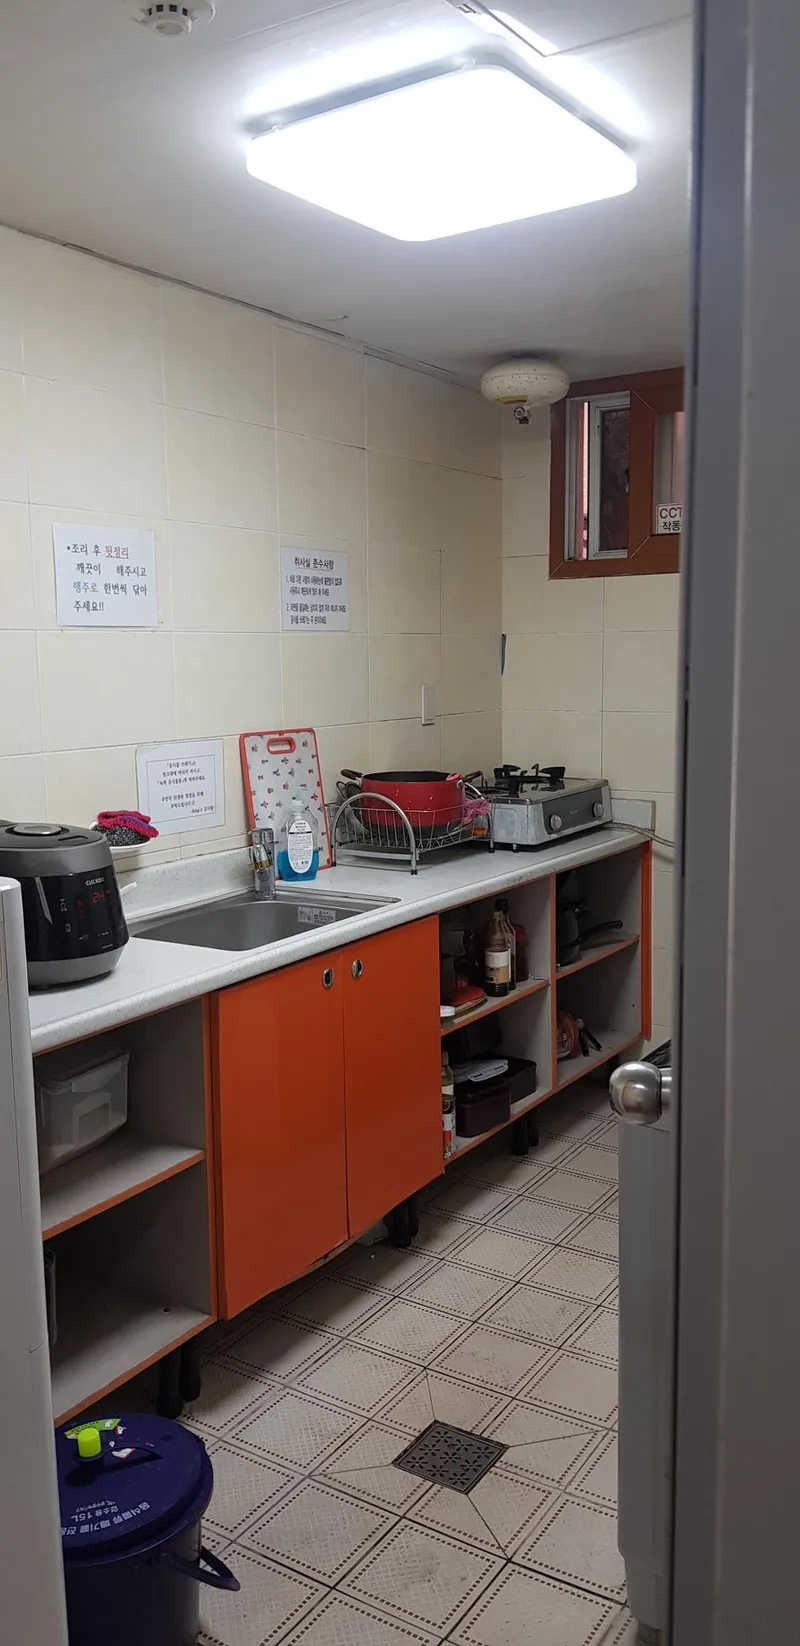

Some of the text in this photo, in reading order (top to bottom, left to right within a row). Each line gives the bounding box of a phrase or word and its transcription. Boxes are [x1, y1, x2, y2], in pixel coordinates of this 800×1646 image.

[662, 520, 681, 532] 작동
[93, 544, 101, 556] 후
[76, 562, 147, 577] 깨끗이 해주시고
[73, 581, 147, 596] 행주로 한번씩 닦아
[73, 600, 104, 613] 주세요!!
[85, 877, 104, 885] CUCKOO
[70, 1512, 93, 1522] 15L
[95, 1505, 119, 1517] 업소용
[113, 1501, 151, 1524] 음식물류
[80, 1520, 111, 1533] 폐기물
